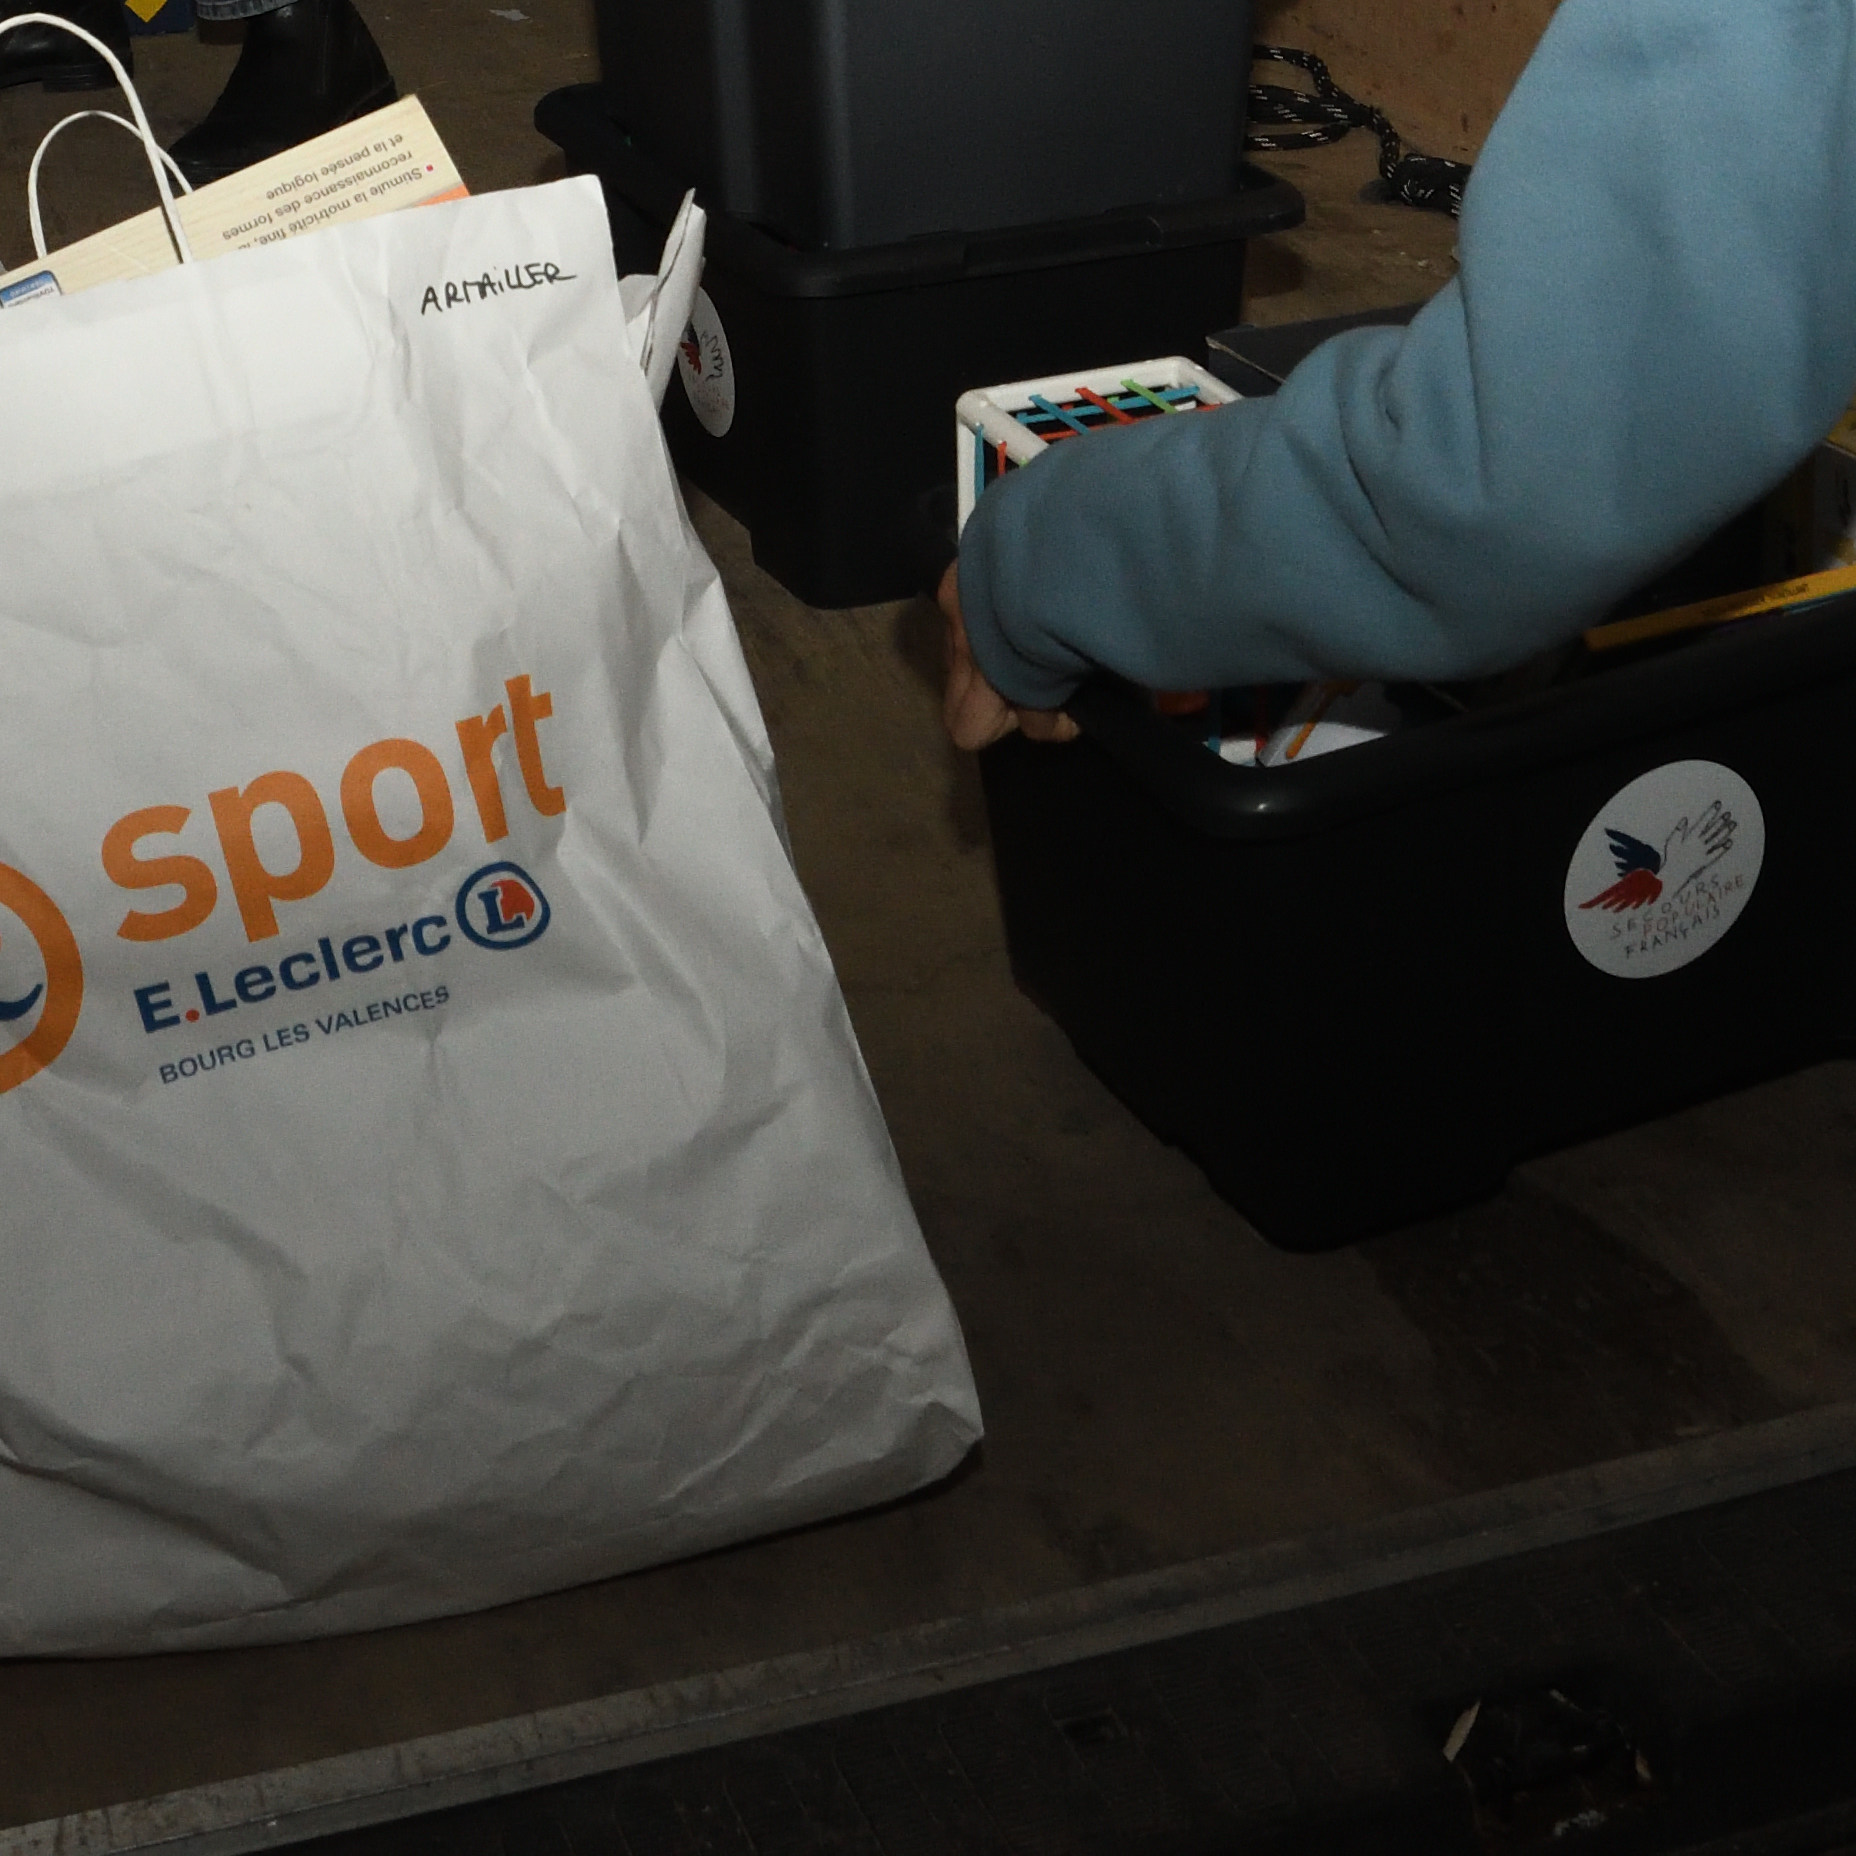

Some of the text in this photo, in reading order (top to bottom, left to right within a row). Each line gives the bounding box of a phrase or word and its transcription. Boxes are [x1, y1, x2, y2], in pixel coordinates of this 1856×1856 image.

[221, 149, 413, 241] reconnaissance des formes
[265, 133, 404, 201] et la pensée logique
[353, 189, 370, 205] la
[369, 167, 424, 196] Stimule
[288, 197, 351, 233] motricité
[100, 673, 567, 943] sport
[1610, 873, 1720, 941] SECOURS
[1625, 904, 1721, 960] FRANÇAIS
[1643, 874, 1745, 936] POPULAIRE
[133, 915, 453, 1034] E.Leclerc
[158, 985, 451, 1084] BOURG LES VALENCES
